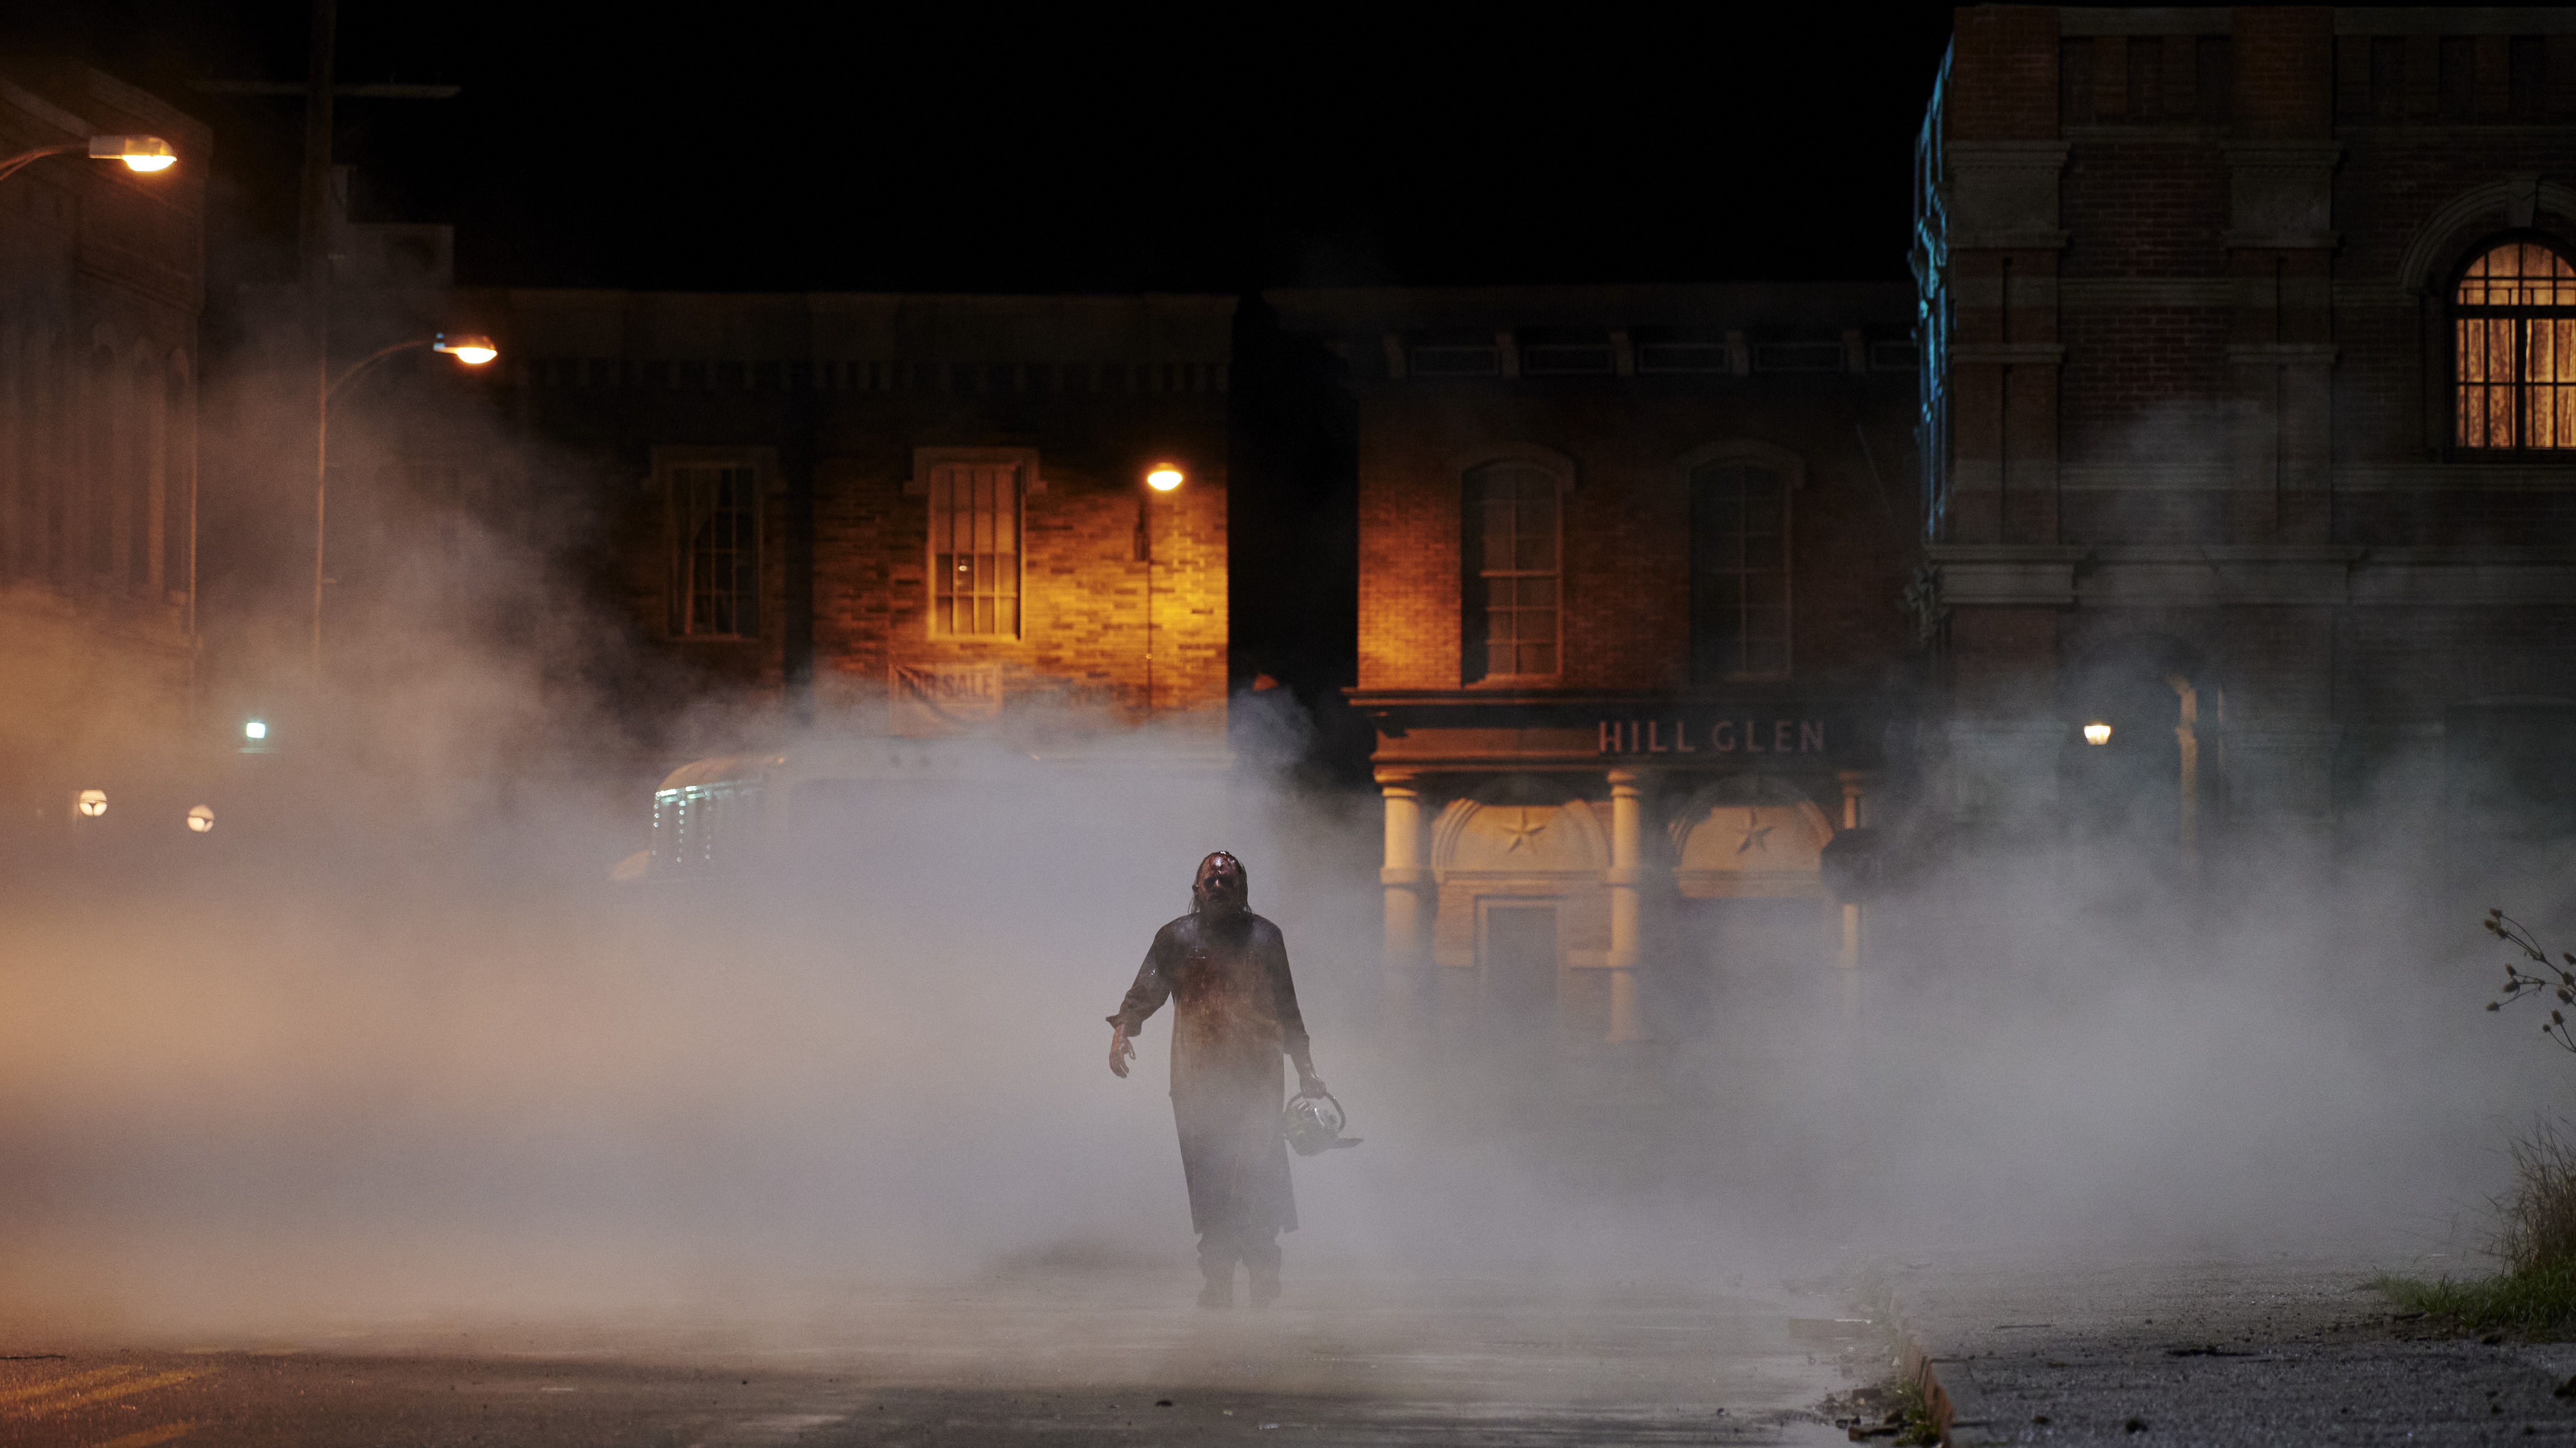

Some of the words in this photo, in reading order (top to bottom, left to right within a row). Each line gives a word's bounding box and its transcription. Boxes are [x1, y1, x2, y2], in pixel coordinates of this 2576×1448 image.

[942, 673, 994, 702] SALE
[1598, 720, 1696, 753] HILL
[1711, 719, 1824, 753] GLEN
